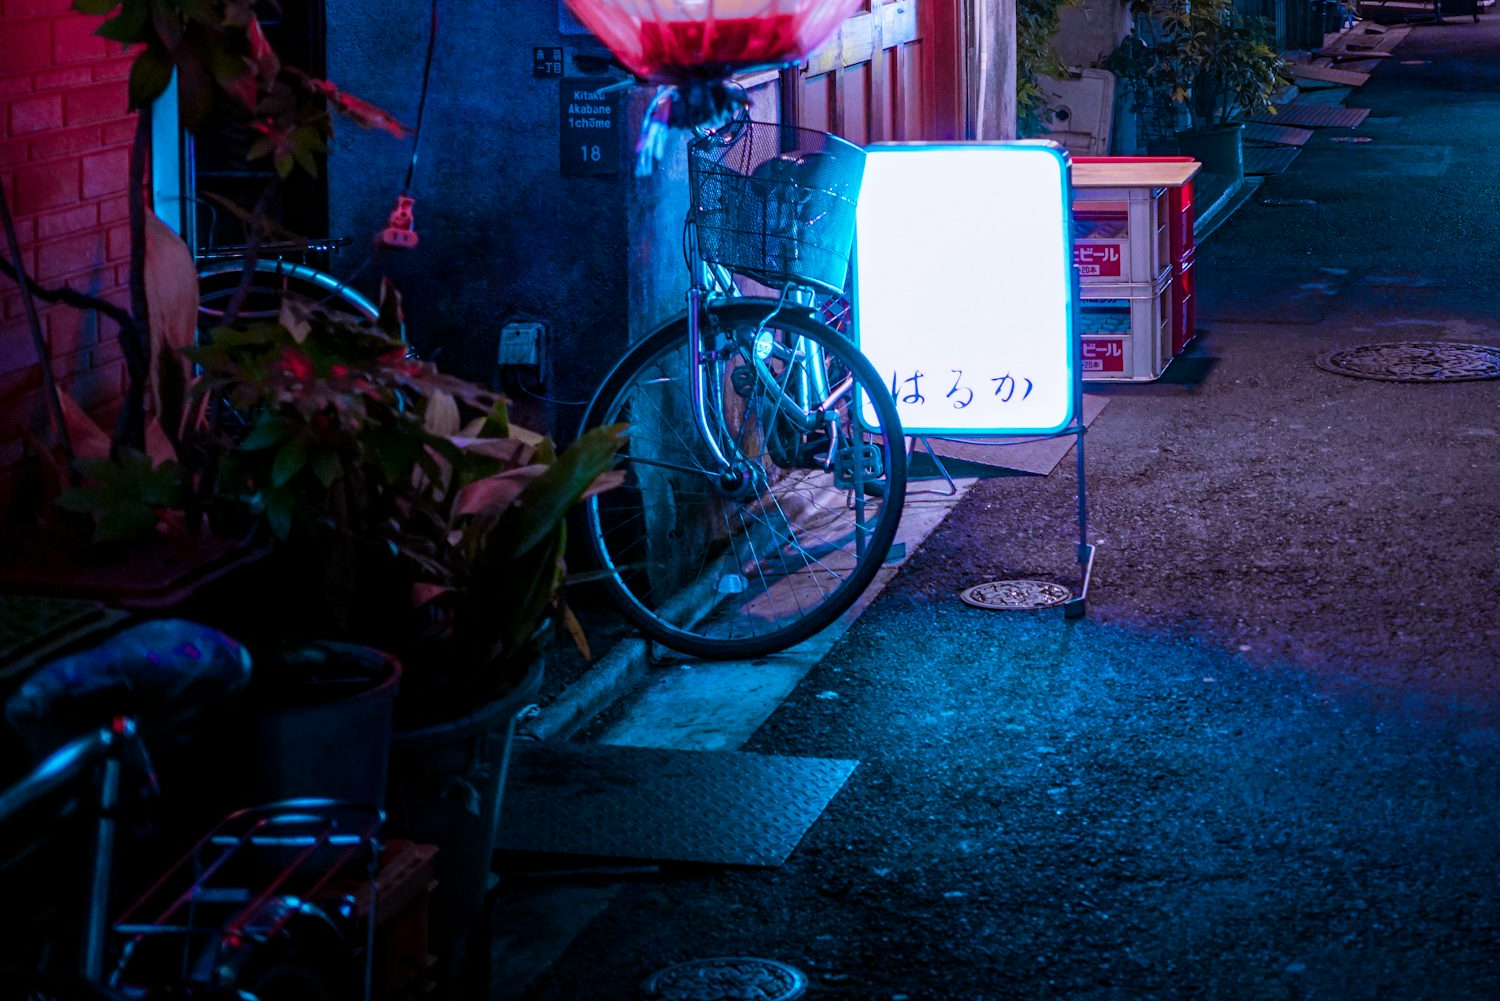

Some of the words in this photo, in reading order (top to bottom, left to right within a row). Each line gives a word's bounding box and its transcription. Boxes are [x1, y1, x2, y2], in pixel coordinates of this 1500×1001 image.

[536, 62, 562, 74] 一丁目
[574, 90, 605, 101] Kitaku
[568, 103, 611, 115] Akabane
[580, 145, 601, 162] 18
[892, 369, 1033, 409] はるか
